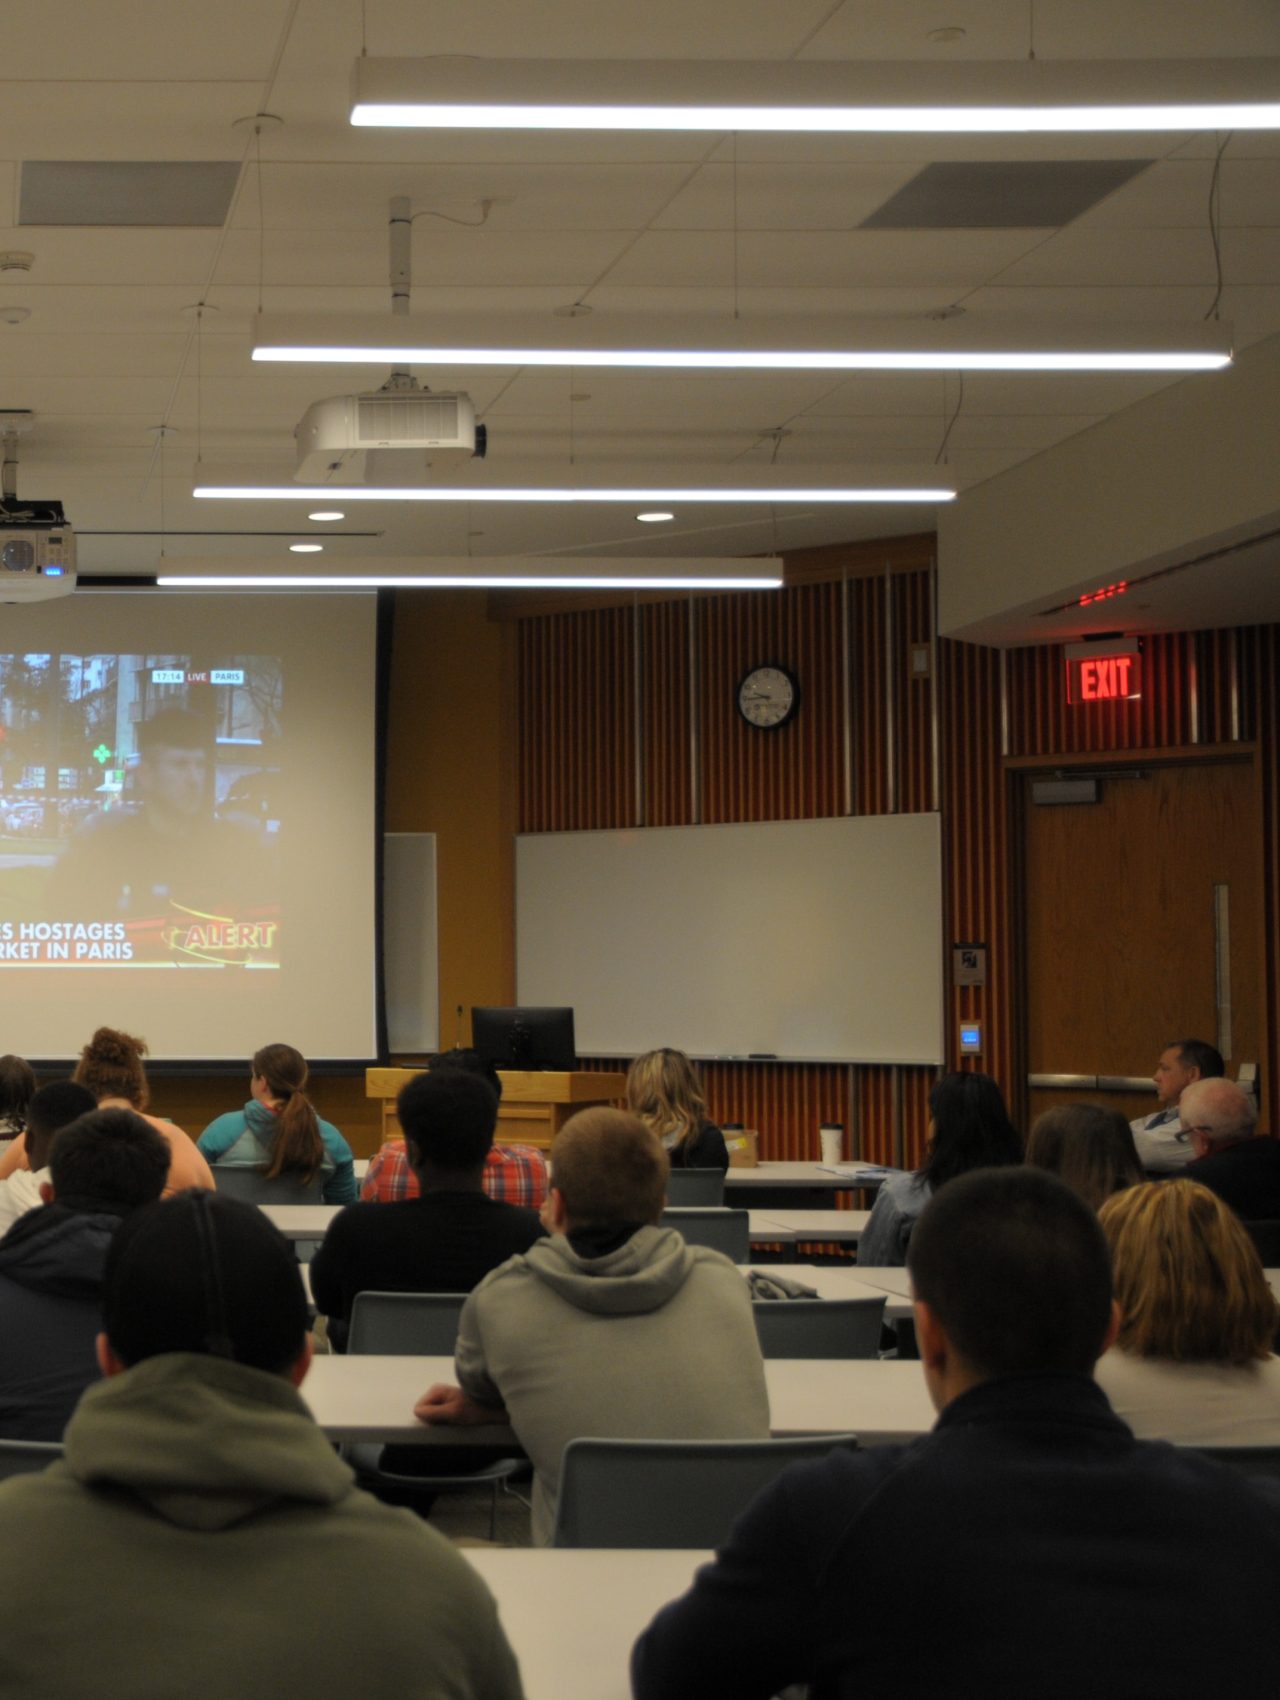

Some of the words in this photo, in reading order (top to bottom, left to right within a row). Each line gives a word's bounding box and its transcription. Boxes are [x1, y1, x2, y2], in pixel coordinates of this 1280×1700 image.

[156, 672, 181, 680] 17:14
[187, 672, 207, 681] LIVE
[215, 672, 240, 680] PARIS
[1081, 658, 1131, 699] EXIT
[20, 922, 125, 940] HOSTAGES
[184, 922, 277, 949] ALERT
[47, 942, 69, 959] IN
[76, 942, 133, 960] PARIS
